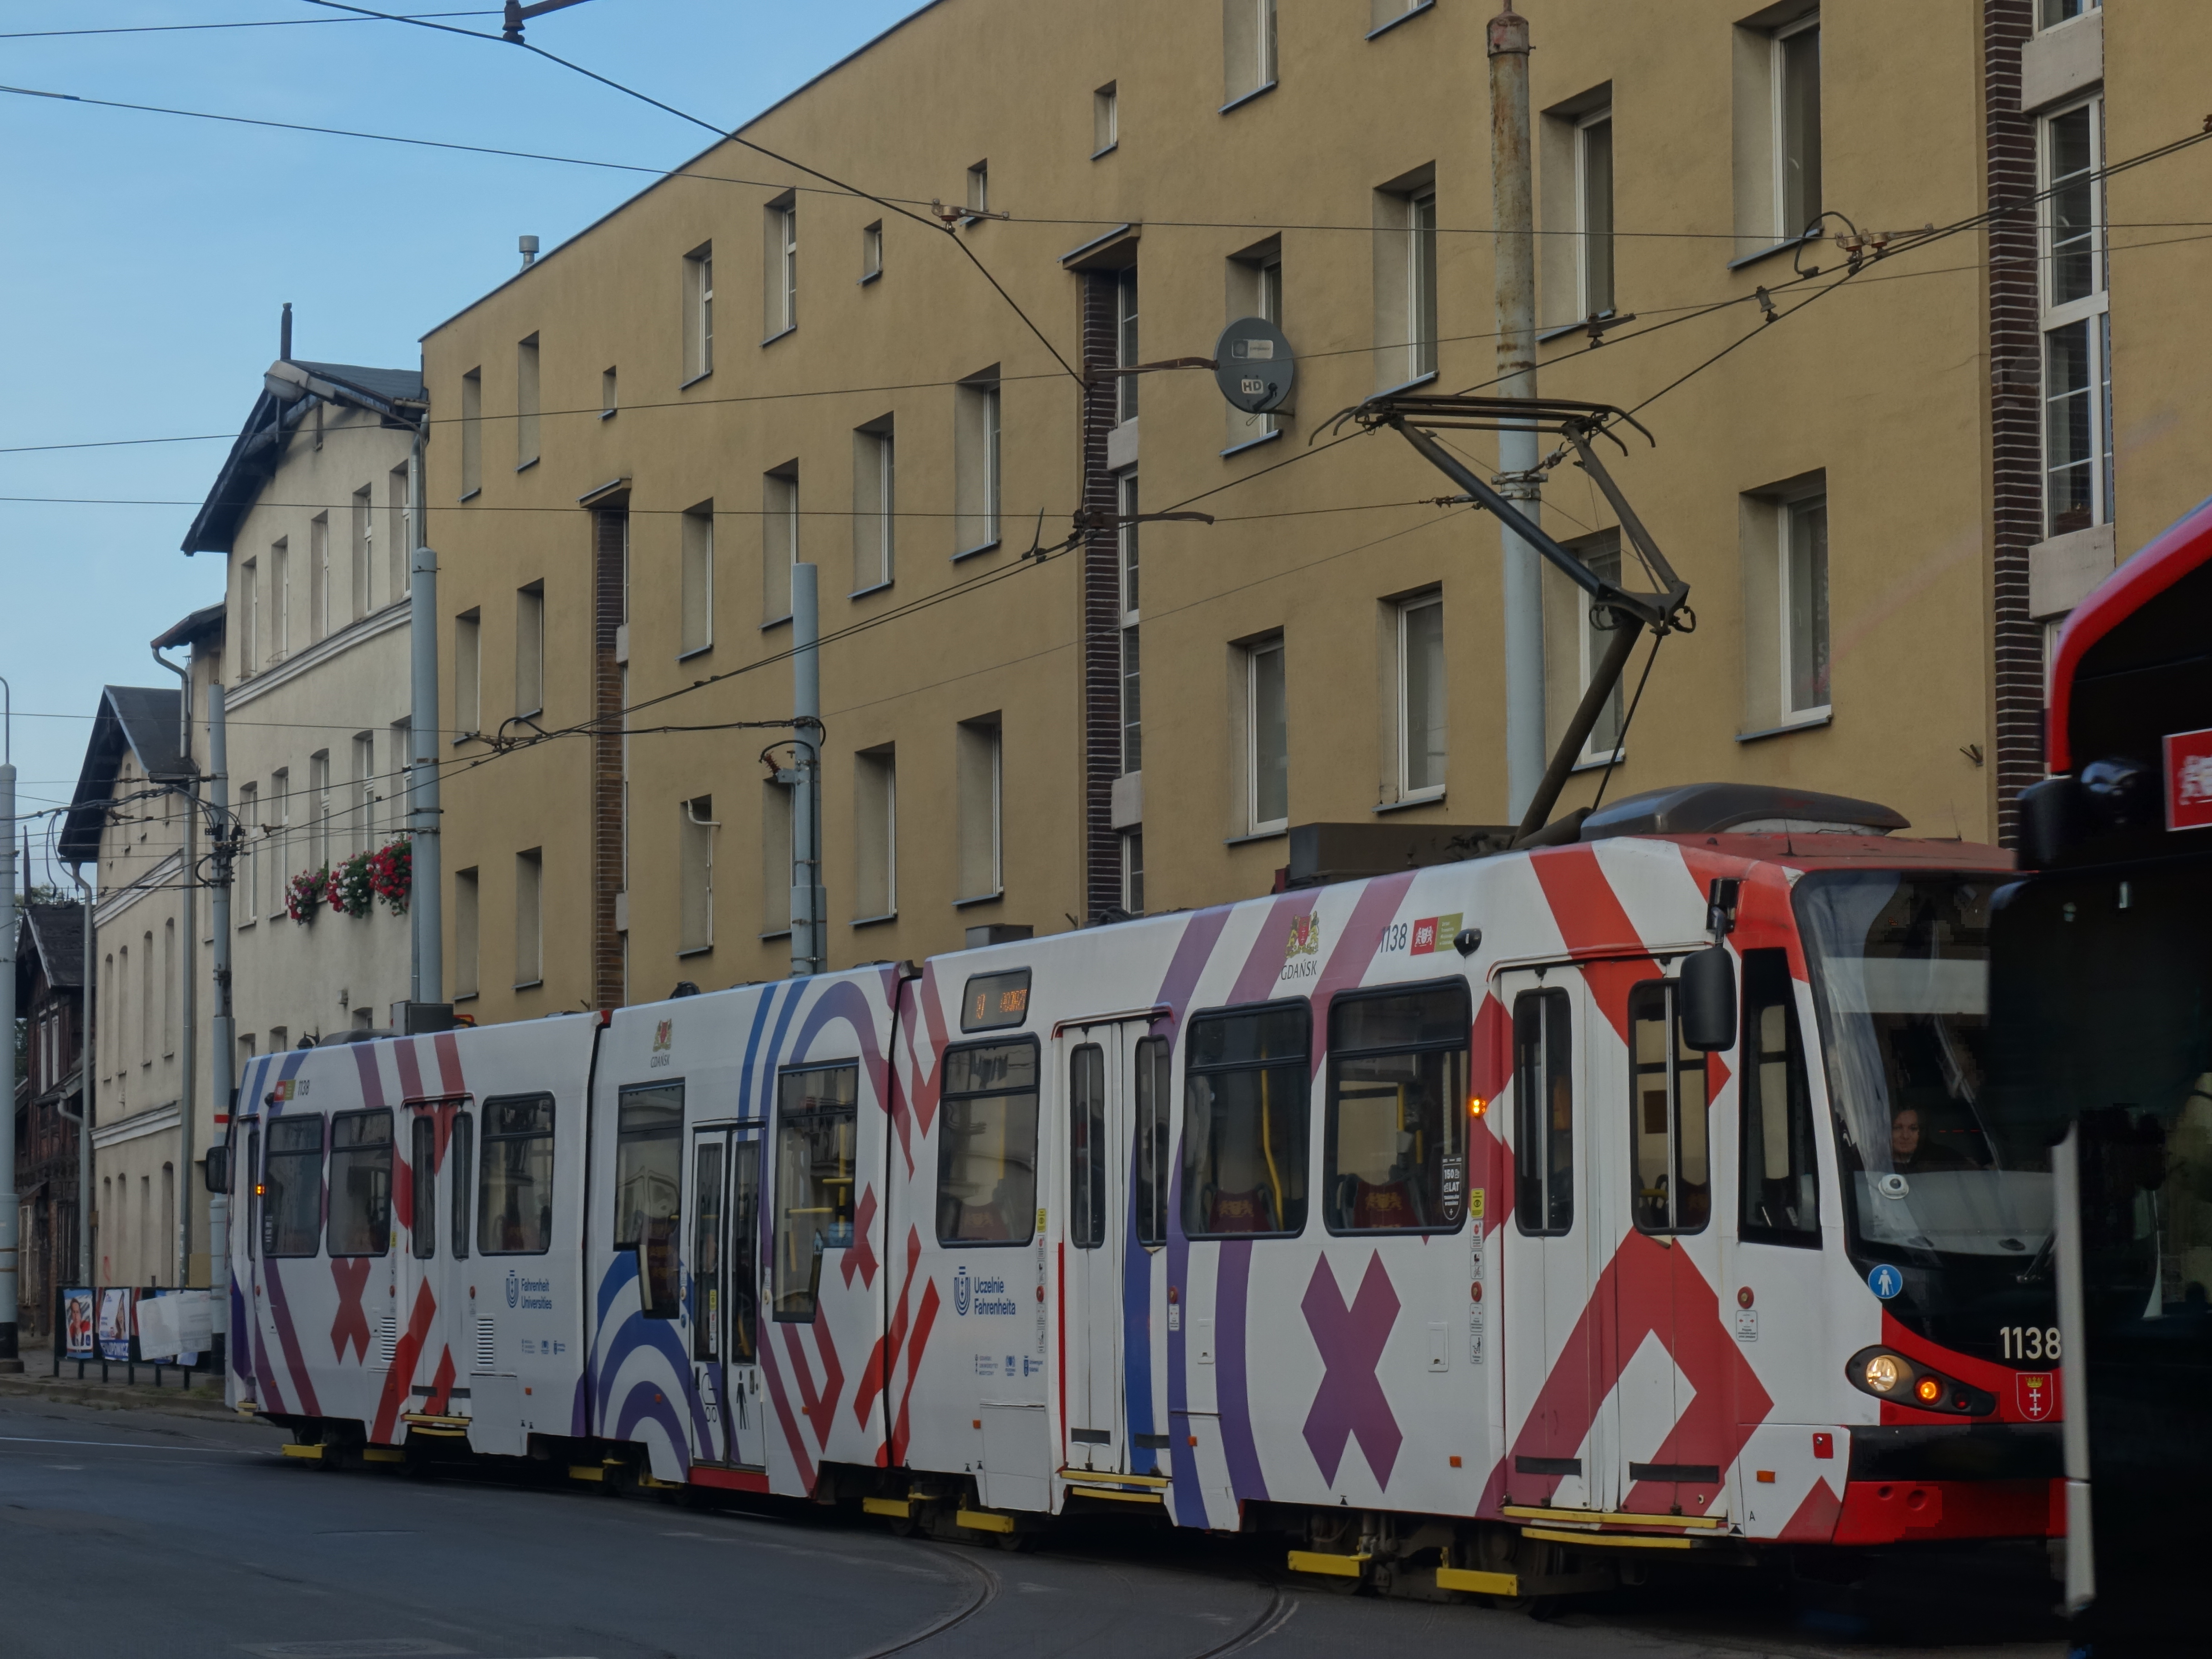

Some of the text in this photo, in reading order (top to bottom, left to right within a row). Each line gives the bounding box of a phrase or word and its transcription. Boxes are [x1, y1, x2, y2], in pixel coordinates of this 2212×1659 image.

[1243, 381, 1262, 392] HD
[1380, 923, 1408, 953] 1138
[1281, 959, 1317, 980] GDAŃSK
[650, 1052, 670, 1068] GDAŃSK
[298, 1080, 310, 1096] 1138
[521, 1278, 549, 1292] Fahrenheit
[974, 1277, 1004, 1294] Uczelnie
[521, 1296, 552, 1310] Universities
[974, 1298, 1016, 1316] Fahrenheita
[2000, 1326, 2061, 1360] 1138
